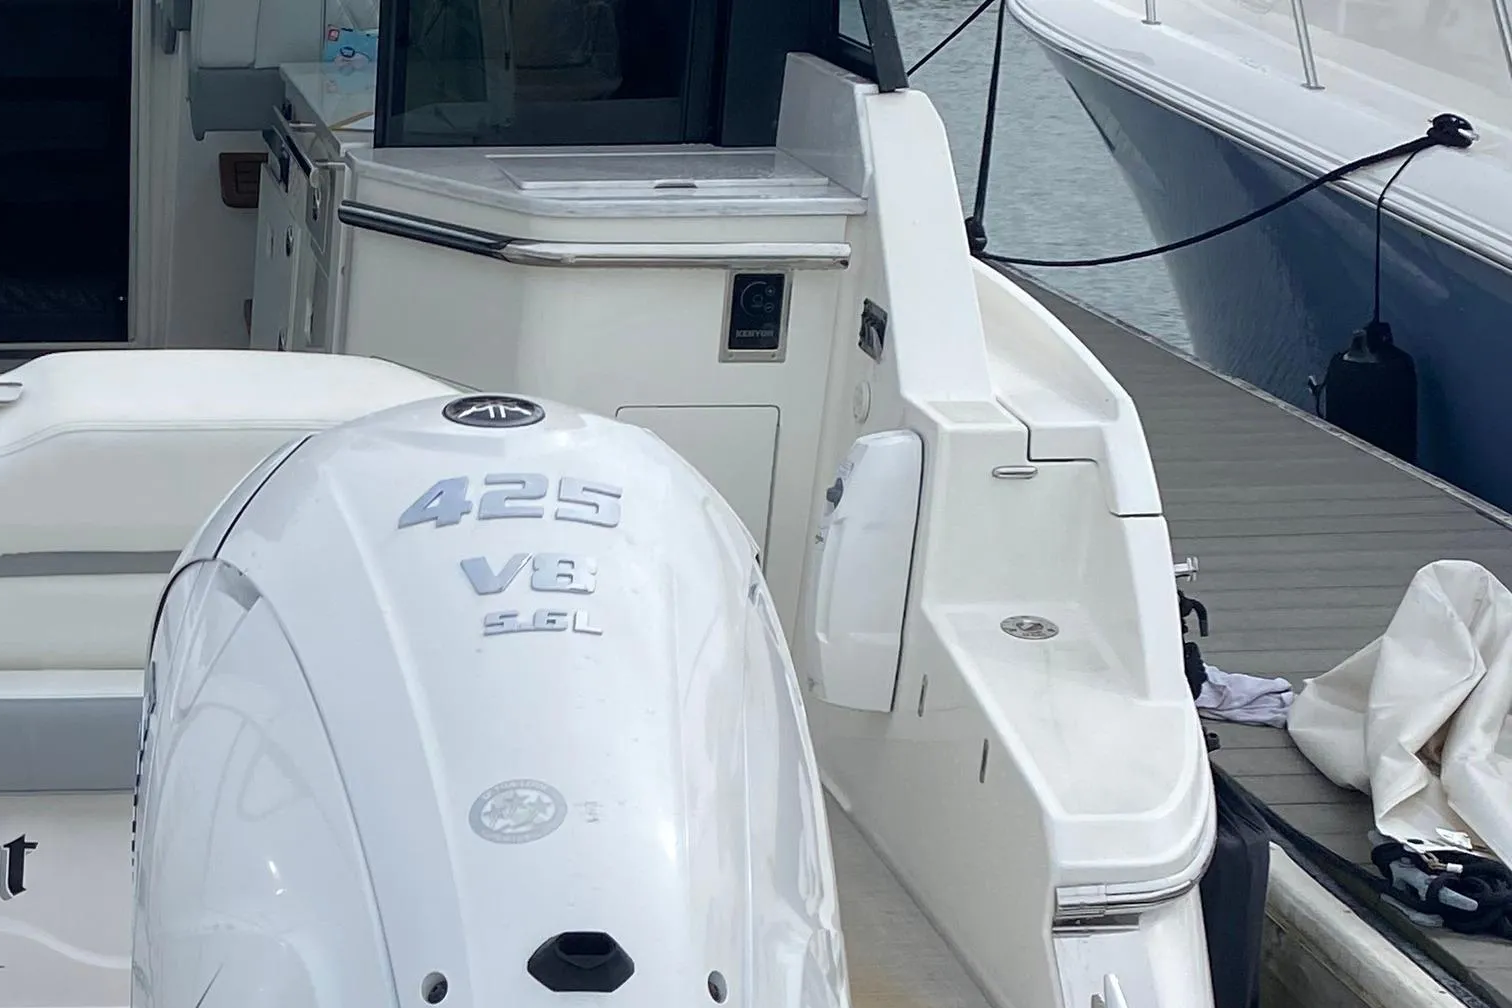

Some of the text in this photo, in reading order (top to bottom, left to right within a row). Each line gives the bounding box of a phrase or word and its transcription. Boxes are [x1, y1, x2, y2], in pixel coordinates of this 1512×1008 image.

[398, 472, 623, 529] 425
[460, 552, 598, 596] V8
[483, 608, 604, 637] 5.6L
